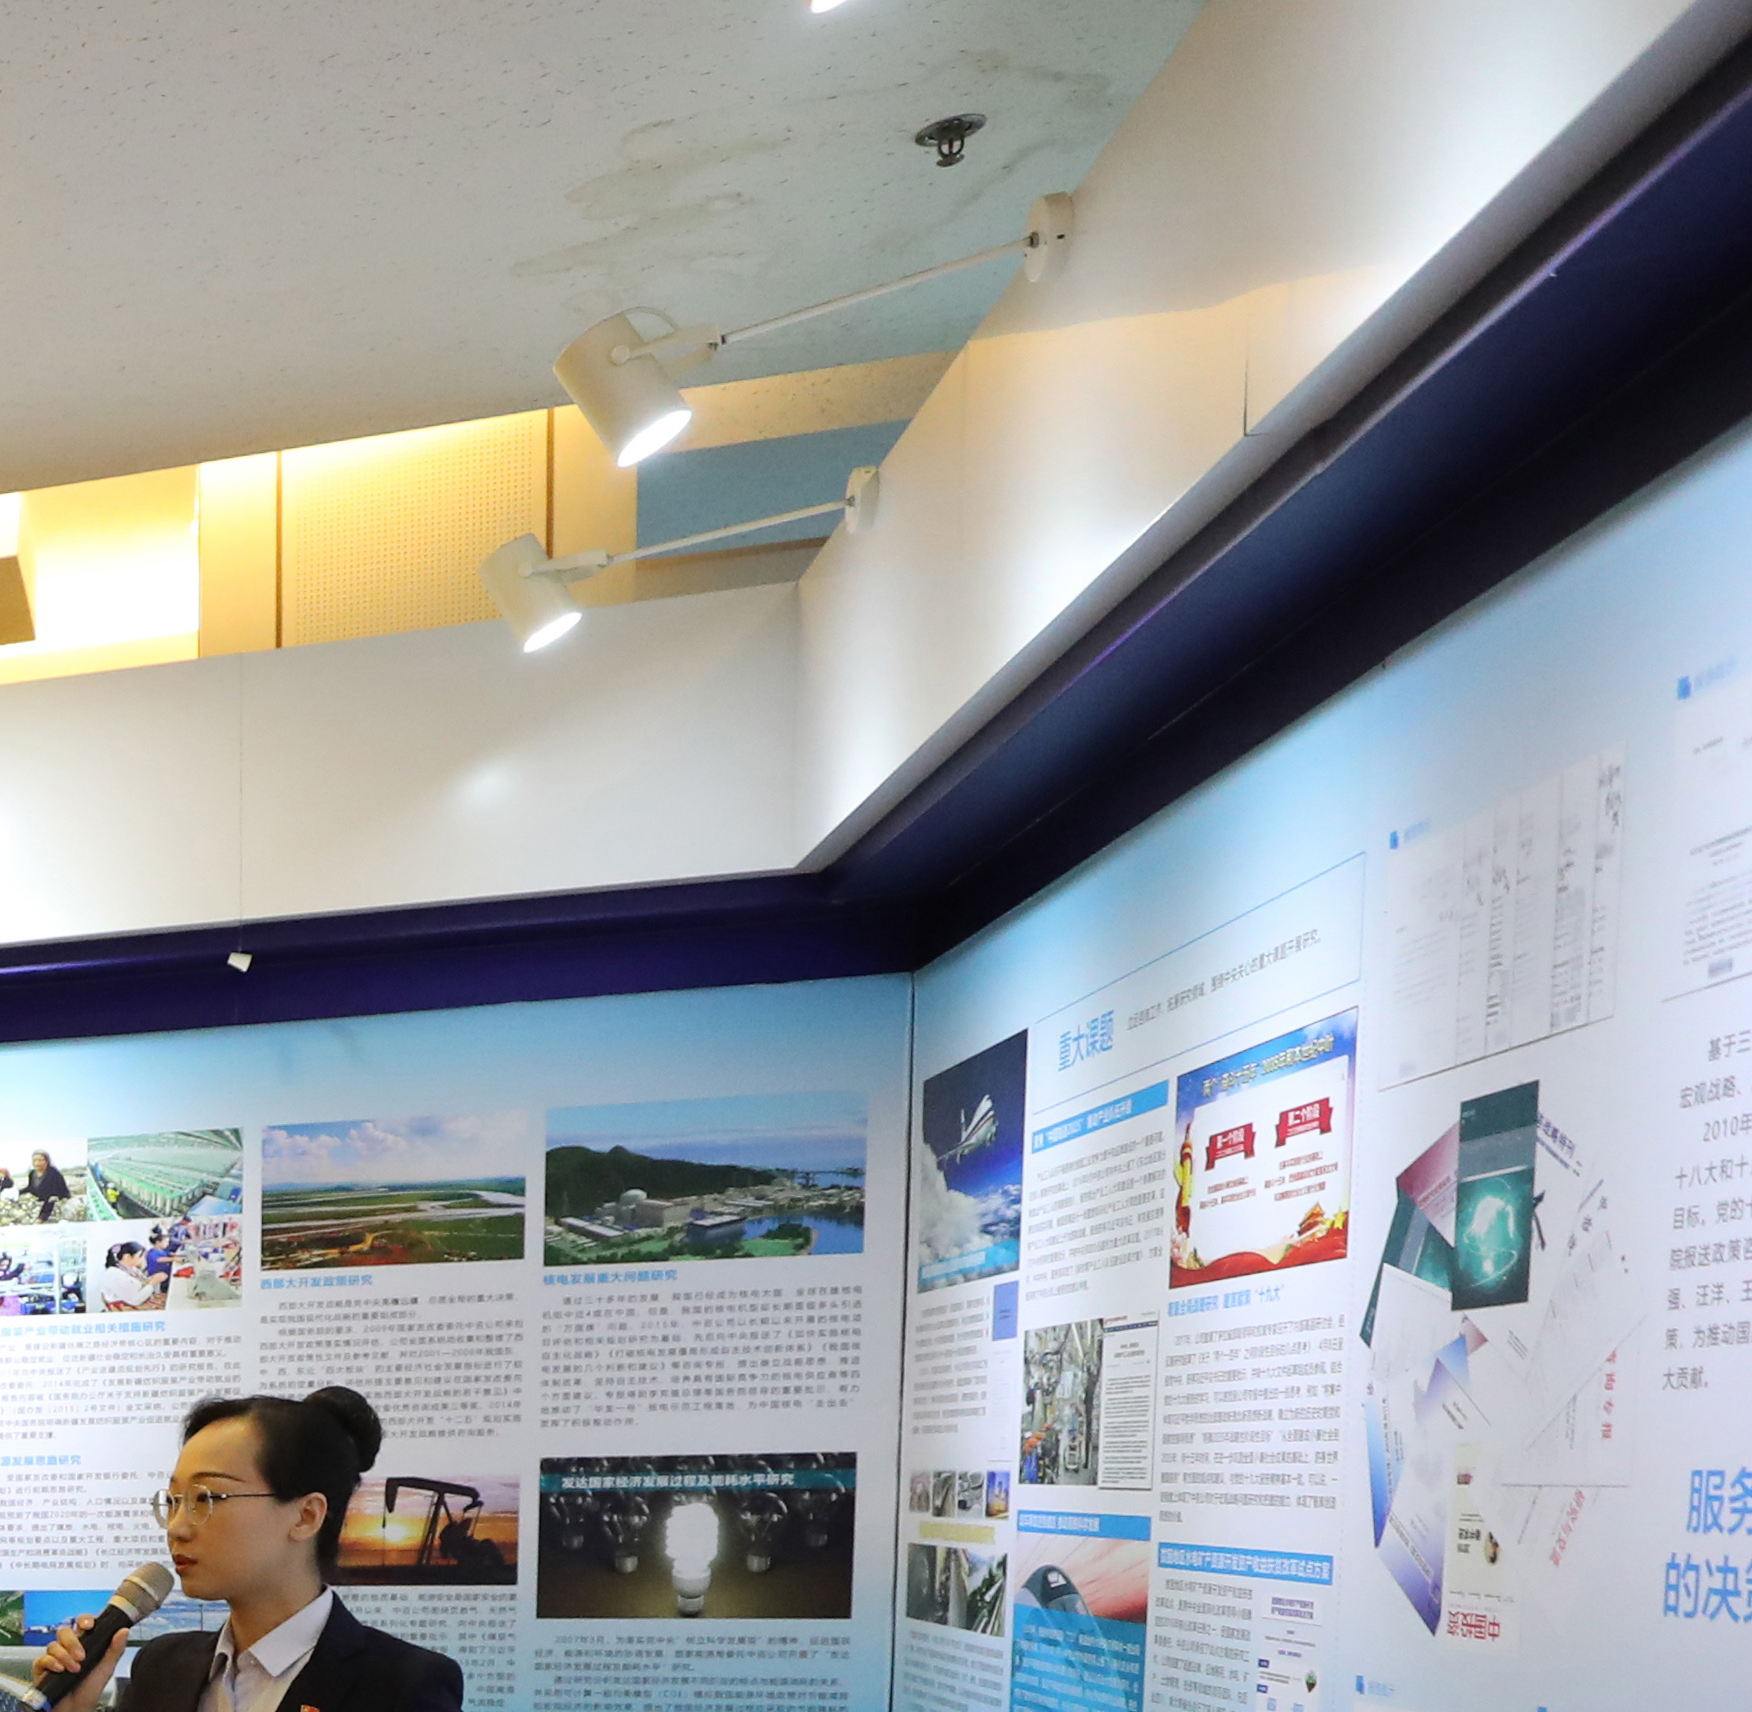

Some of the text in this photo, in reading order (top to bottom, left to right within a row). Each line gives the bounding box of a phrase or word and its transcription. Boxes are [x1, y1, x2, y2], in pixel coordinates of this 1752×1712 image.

[1059, 1010, 1114, 1073] 重大课题
[1708, 1030, 1751, 1062] 基于三
[1703, 1113, 1752, 1142] 2010年
[1675, 1155, 1752, 1189] 十八大和十
[261, 1274, 373, 1289] 西部大开发政策研究
[543, 1269, 678, 1286] 核电发展重大问题研究
[561, 1473, 795, 1488] 发达国家经济发展过程及能耗水平研究
[1687, 1466, 1752, 1535] 服务
[1664, 1552, 1752, 1622] 的决
